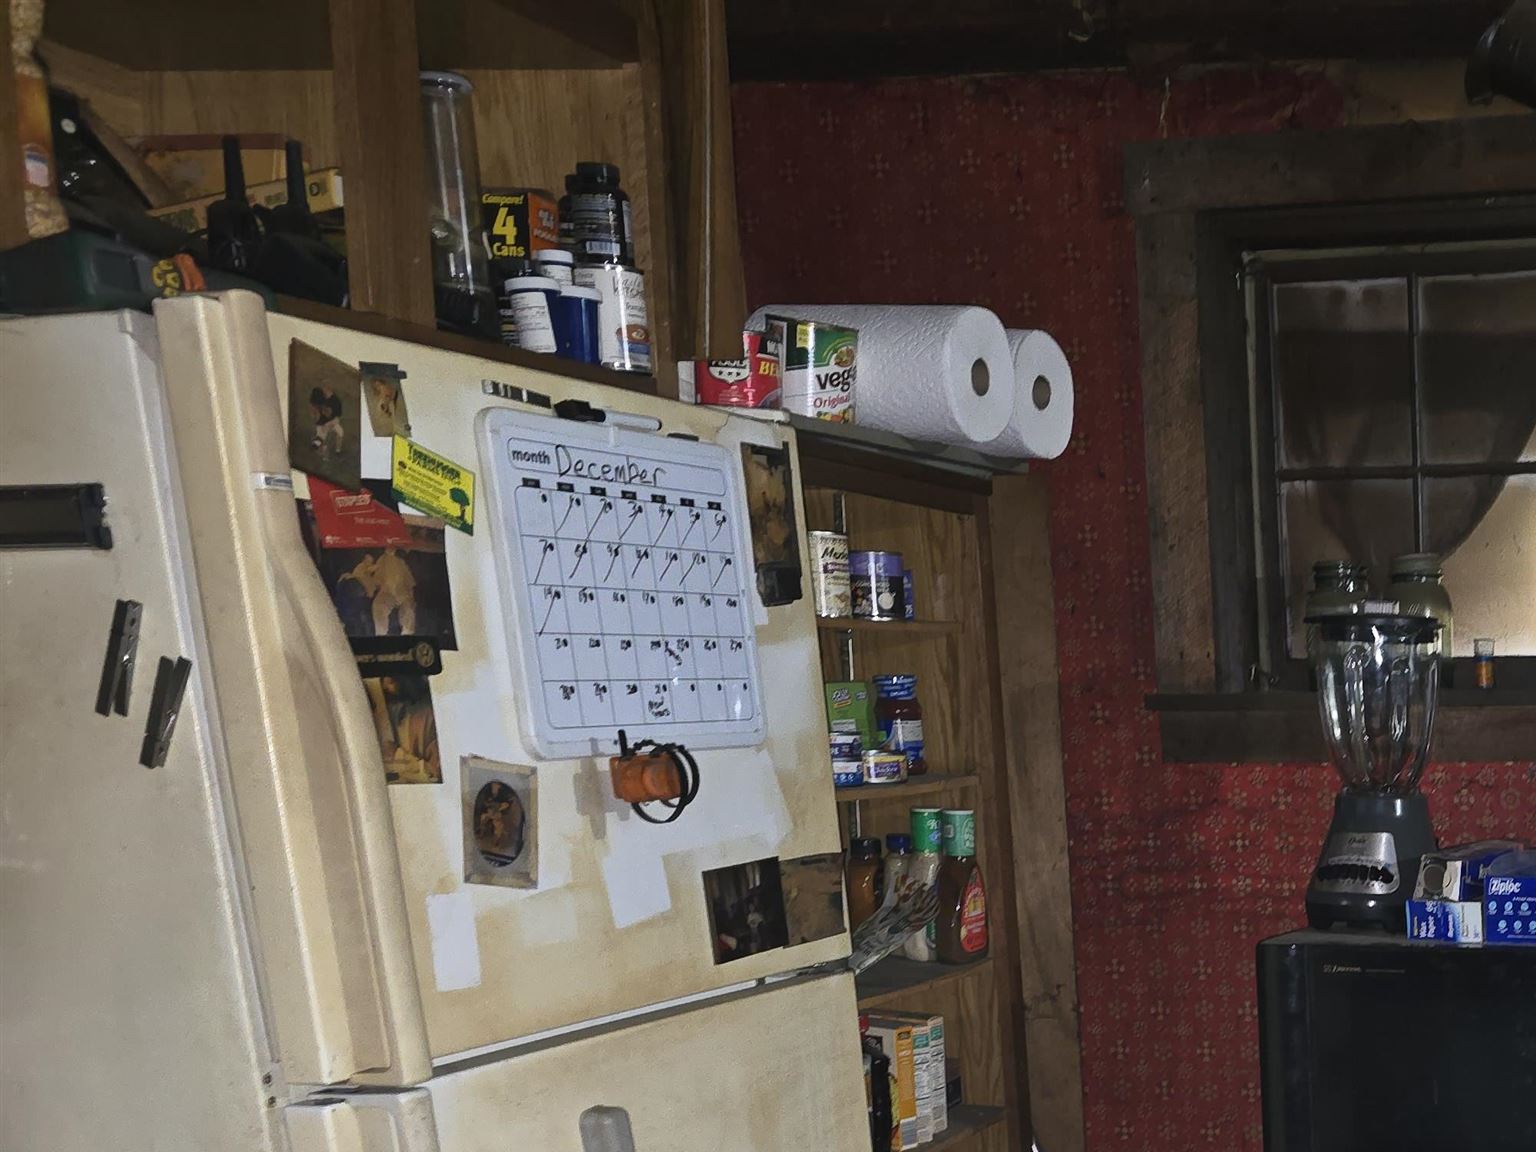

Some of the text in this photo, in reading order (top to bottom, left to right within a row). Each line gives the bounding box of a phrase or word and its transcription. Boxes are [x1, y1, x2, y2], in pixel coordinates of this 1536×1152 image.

[492, 207, 518, 245] 4
[493, 242, 526, 257] Cans
[511, 449, 551, 465] month
[554, 444, 667, 486] December
[1490, 879, 1521, 894] Ziploc
